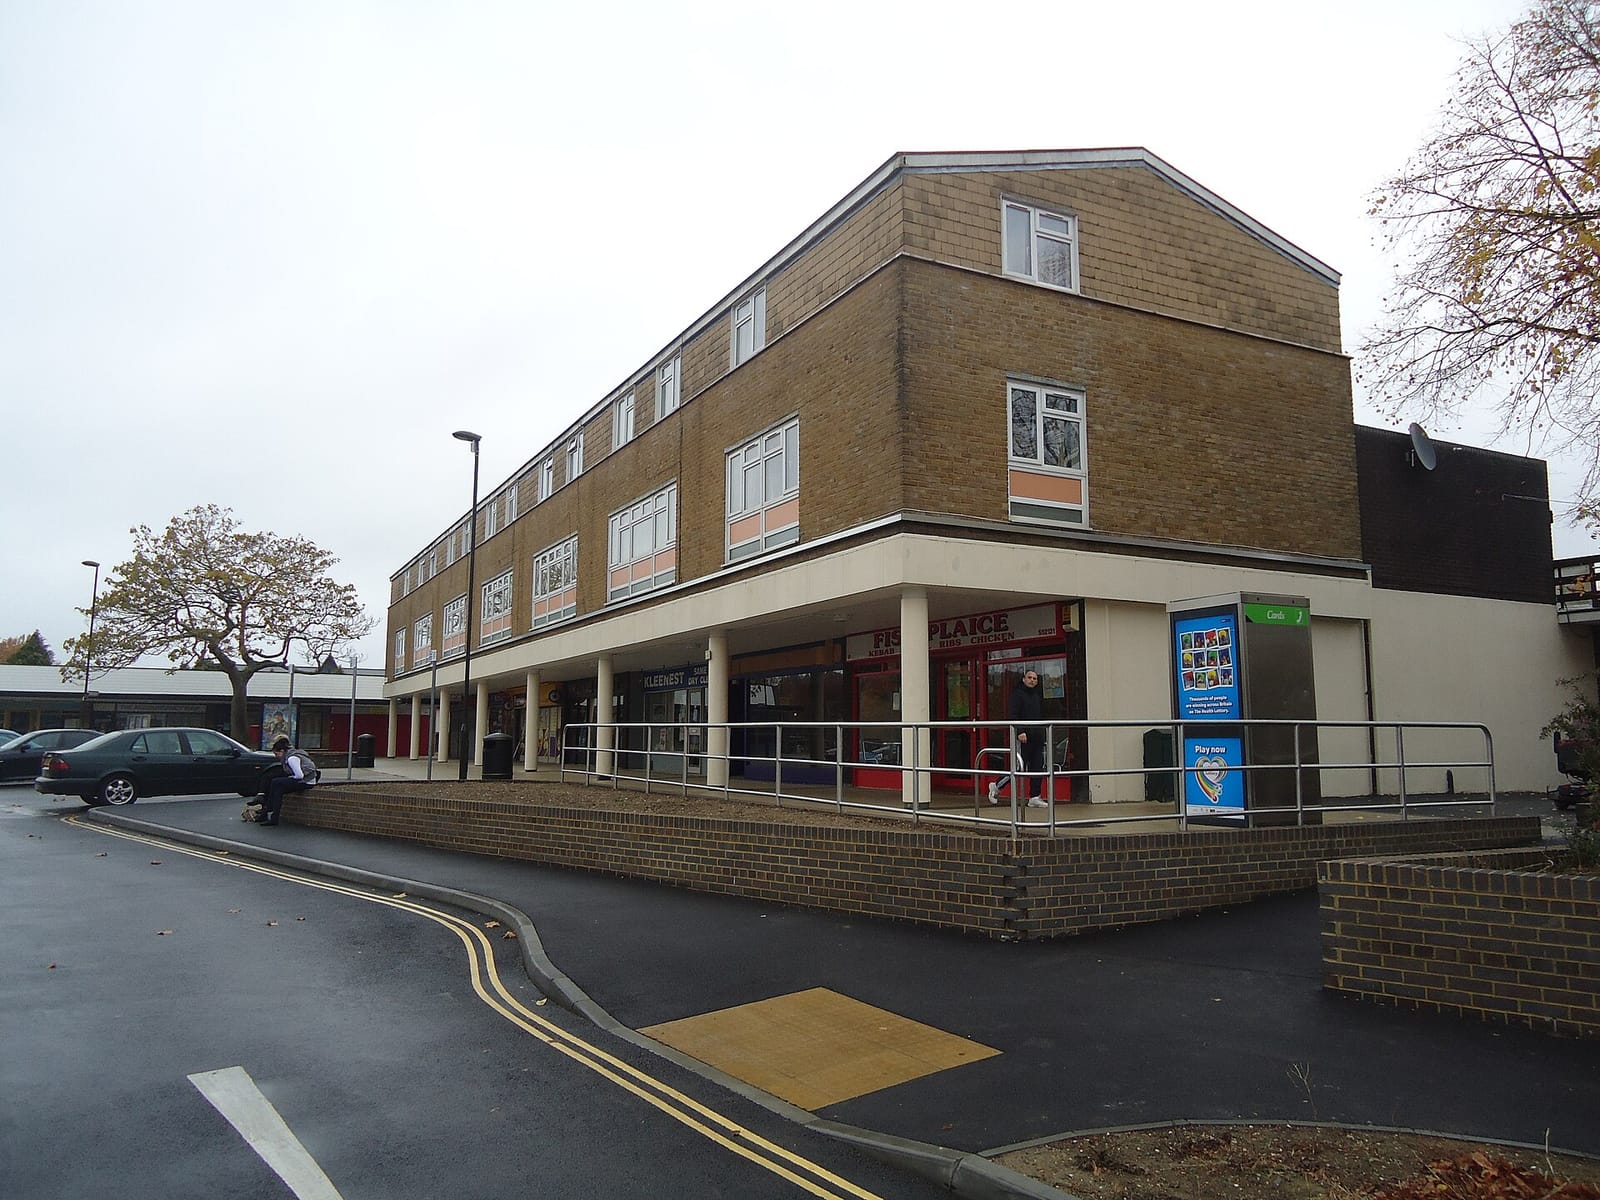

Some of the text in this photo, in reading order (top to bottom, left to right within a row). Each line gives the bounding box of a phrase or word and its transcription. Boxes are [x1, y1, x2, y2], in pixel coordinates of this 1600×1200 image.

[873, 613, 1009, 649] FIS PLAICE
[868, 632, 1015, 657] KEBAB RIBS CHICKEN
[644, 671, 685, 688] KLEENEST
[1195, 745, 1209, 754] Play
